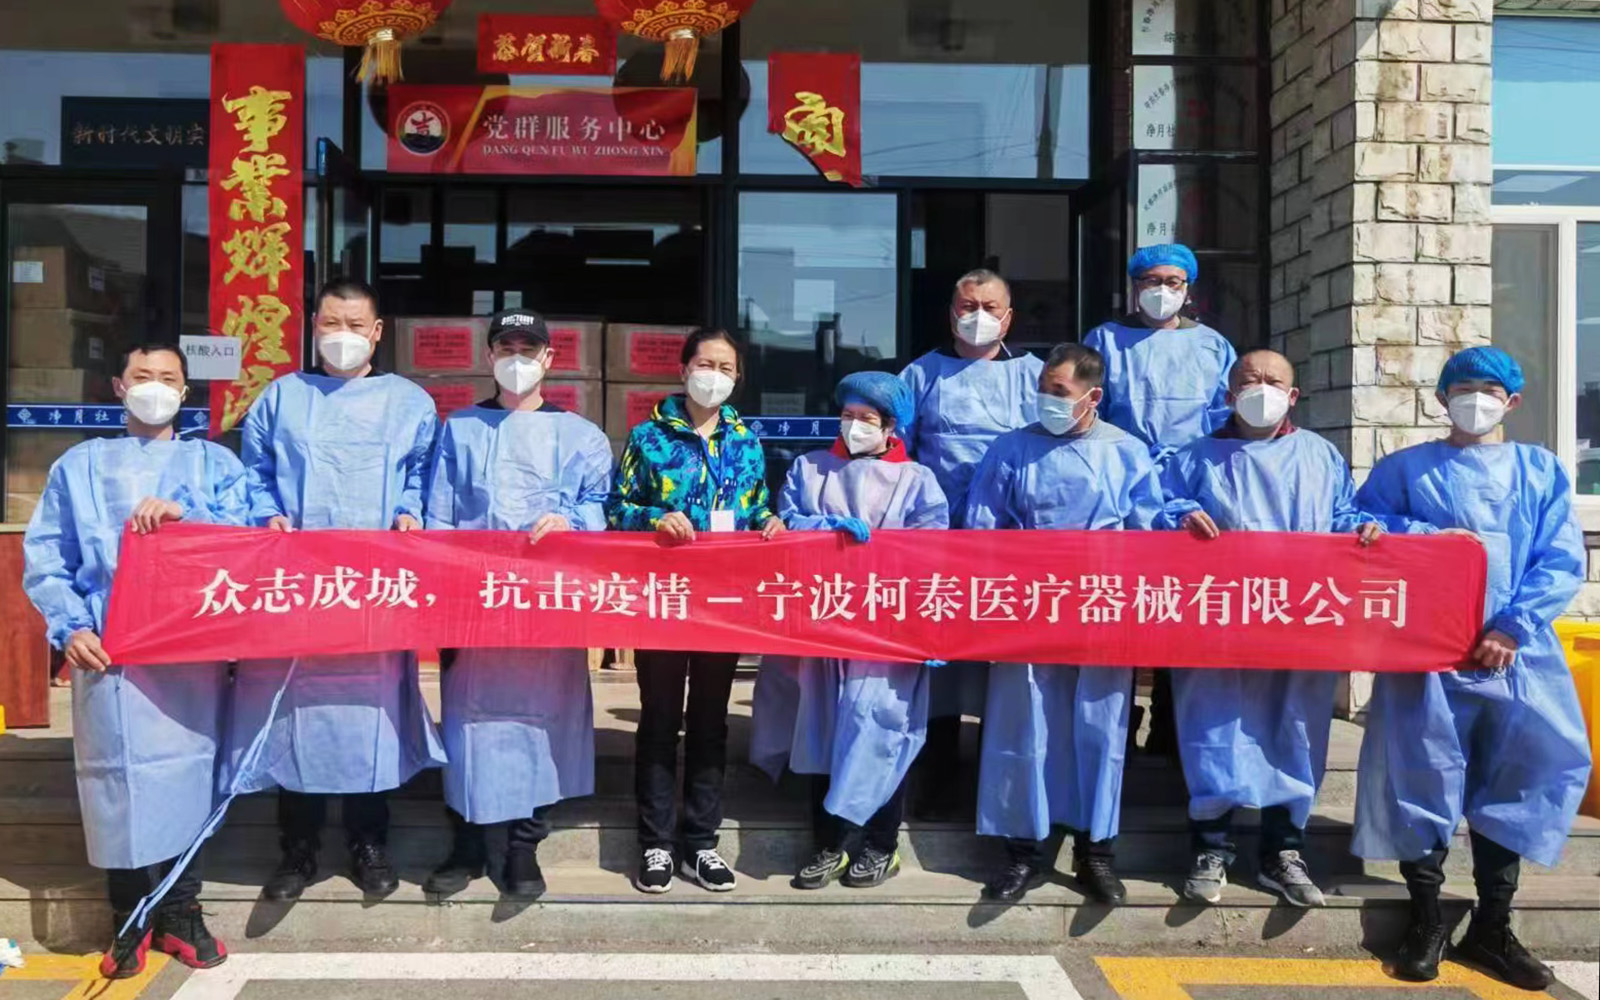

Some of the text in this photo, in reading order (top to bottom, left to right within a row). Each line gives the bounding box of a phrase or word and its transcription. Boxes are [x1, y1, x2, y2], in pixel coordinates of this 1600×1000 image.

[483, 115, 665, 142] 党群服务中心
[483, 145, 665, 156] DANG QUN FU WU ZHONG XIN
[186, 344, 235, 357] 核酸入口
